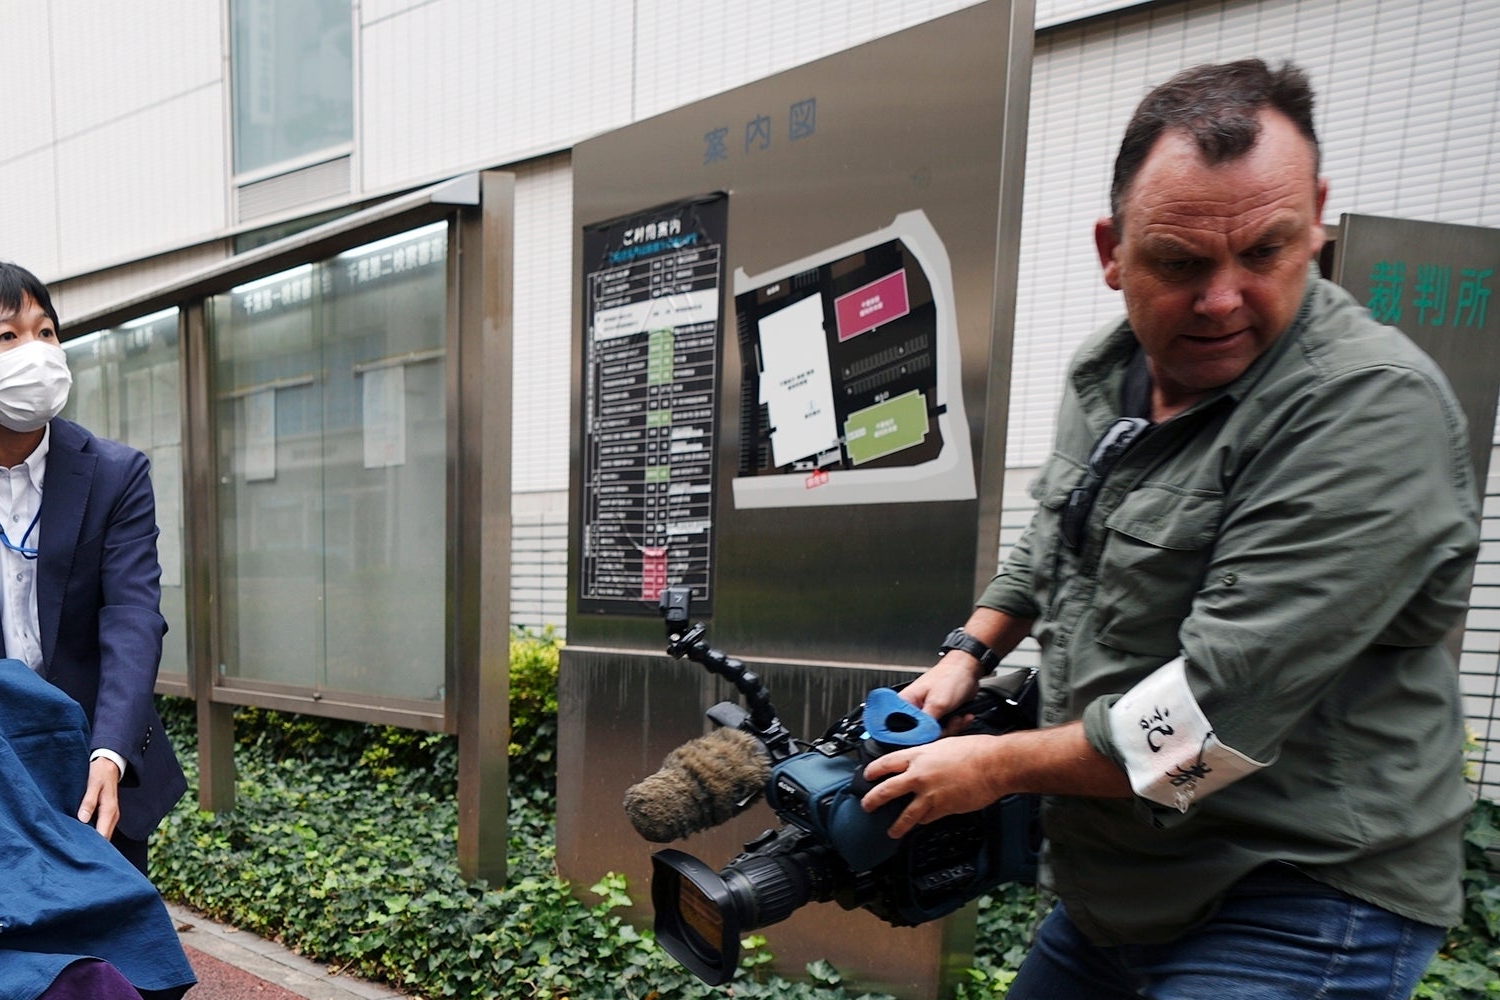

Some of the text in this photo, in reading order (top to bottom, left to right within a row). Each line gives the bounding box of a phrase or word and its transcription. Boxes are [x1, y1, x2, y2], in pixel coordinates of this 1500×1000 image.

[702, 97, 817, 166] 案内図
[1366, 259, 1494, 330] 裁判所
